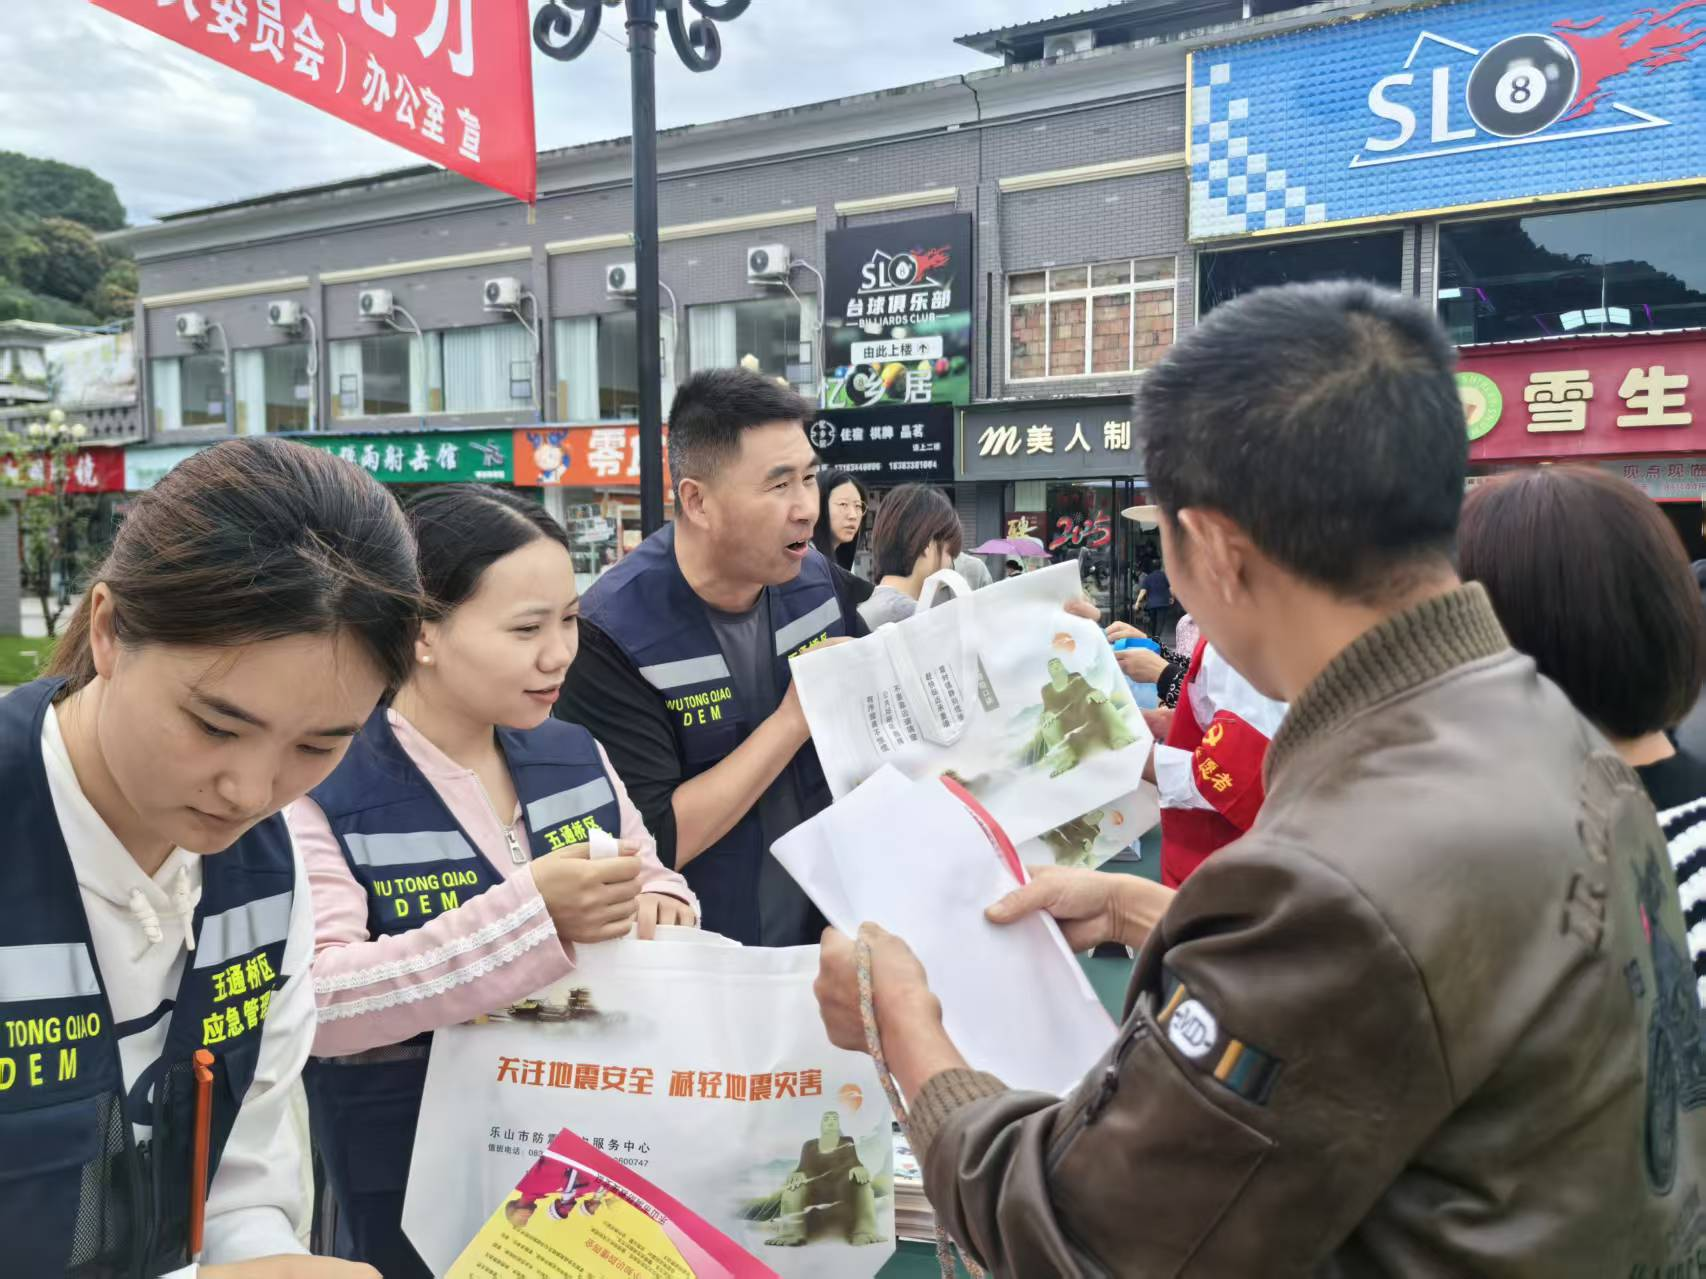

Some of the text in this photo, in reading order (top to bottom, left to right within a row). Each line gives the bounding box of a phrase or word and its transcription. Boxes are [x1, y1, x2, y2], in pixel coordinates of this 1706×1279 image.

[456, 106, 482, 163] 宣
[846, 290, 952, 318] 台球俱乐部
[909, 311, 936, 324] CLUB
[863, 343, 913, 359] 由此上楼
[665, 687, 732, 712] WU TONG QIAO
[394, 873, 440, 895] TONG
[442, 869, 478, 888] QIAO
[212, 952, 276, 1003] 五通桥区
[6, 1012, 100, 1048] TONG QIAO
[496, 1055, 824, 1103] 关注地震安全 减轻地震灾害
